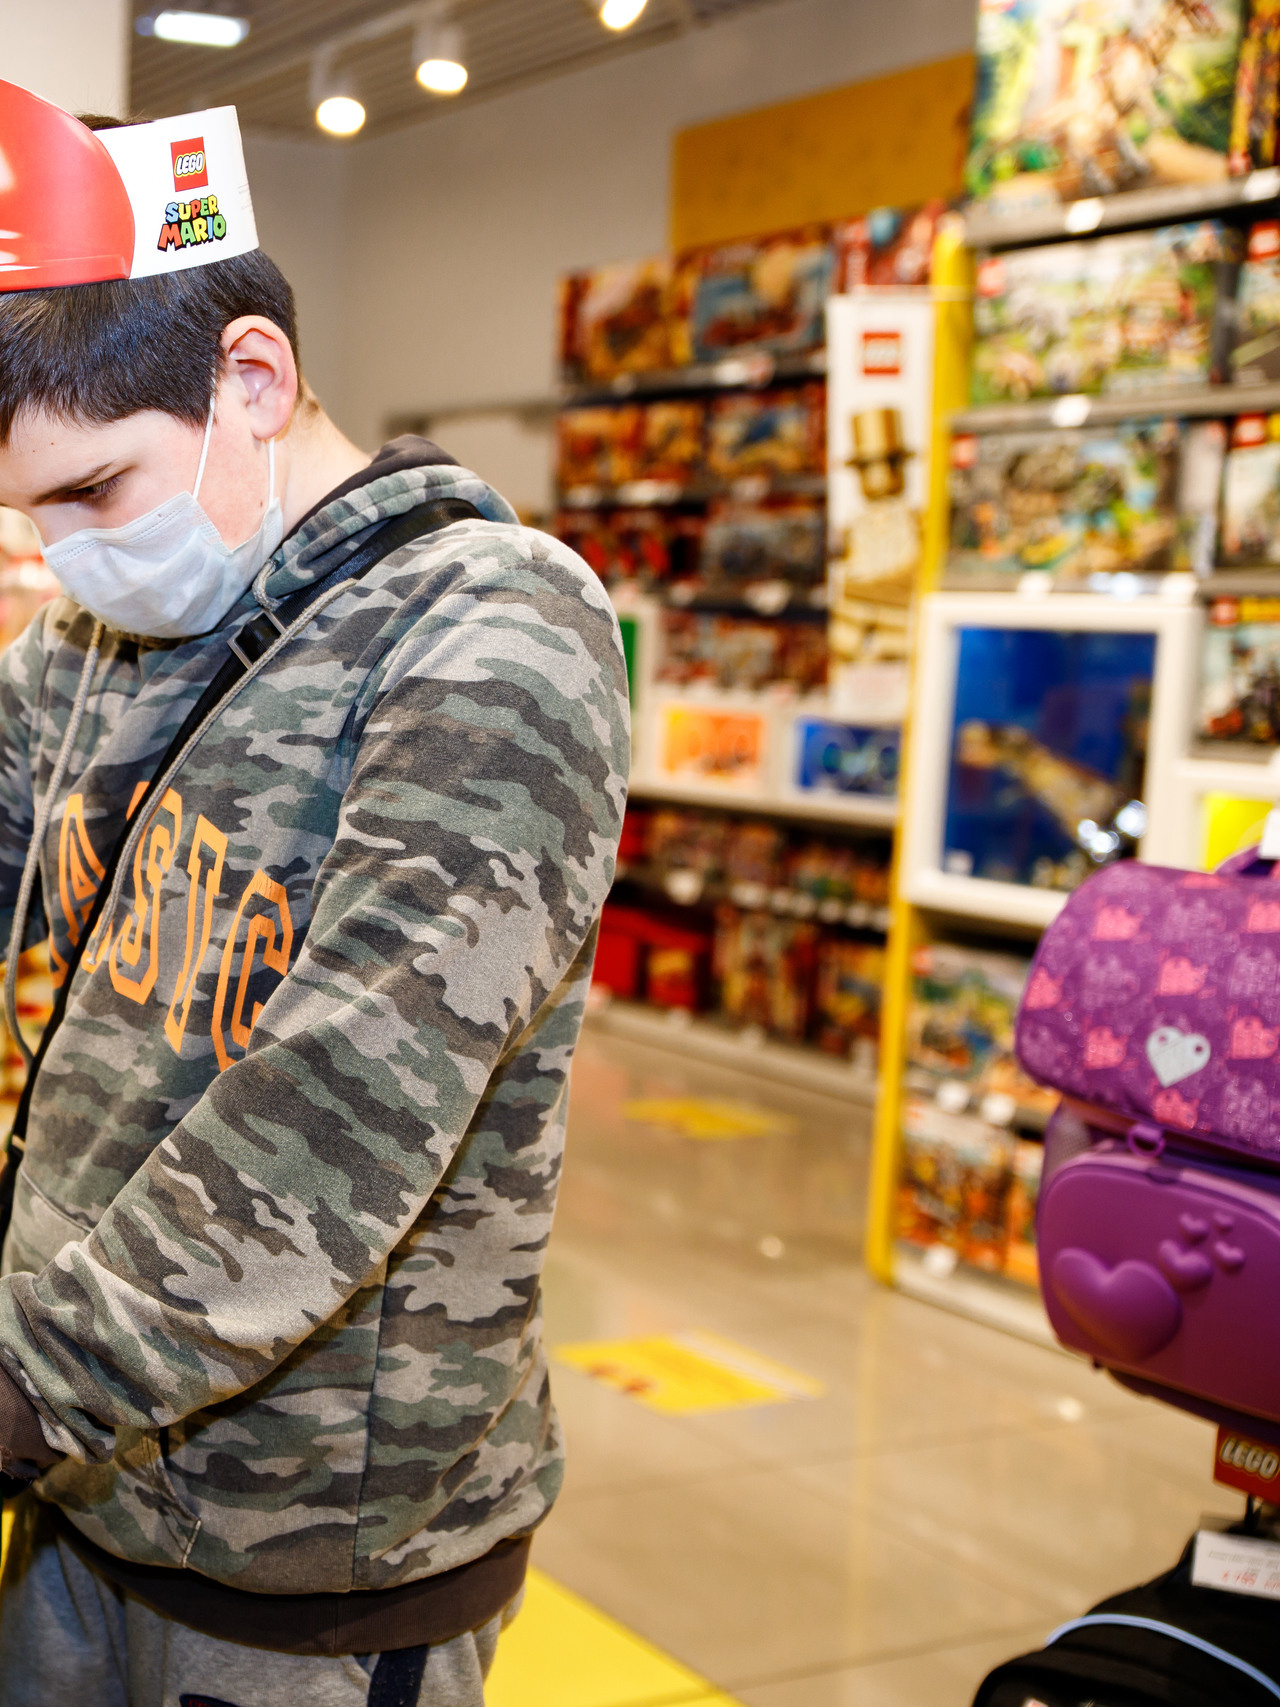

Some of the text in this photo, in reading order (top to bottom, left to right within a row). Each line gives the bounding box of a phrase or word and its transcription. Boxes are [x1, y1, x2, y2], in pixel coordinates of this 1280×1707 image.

[175, 151, 205, 177] LEGO
[165, 194, 219, 223] SUPER
[157, 214, 227, 252] MARIO
[1220, 1437, 1279, 1480] LEGO
